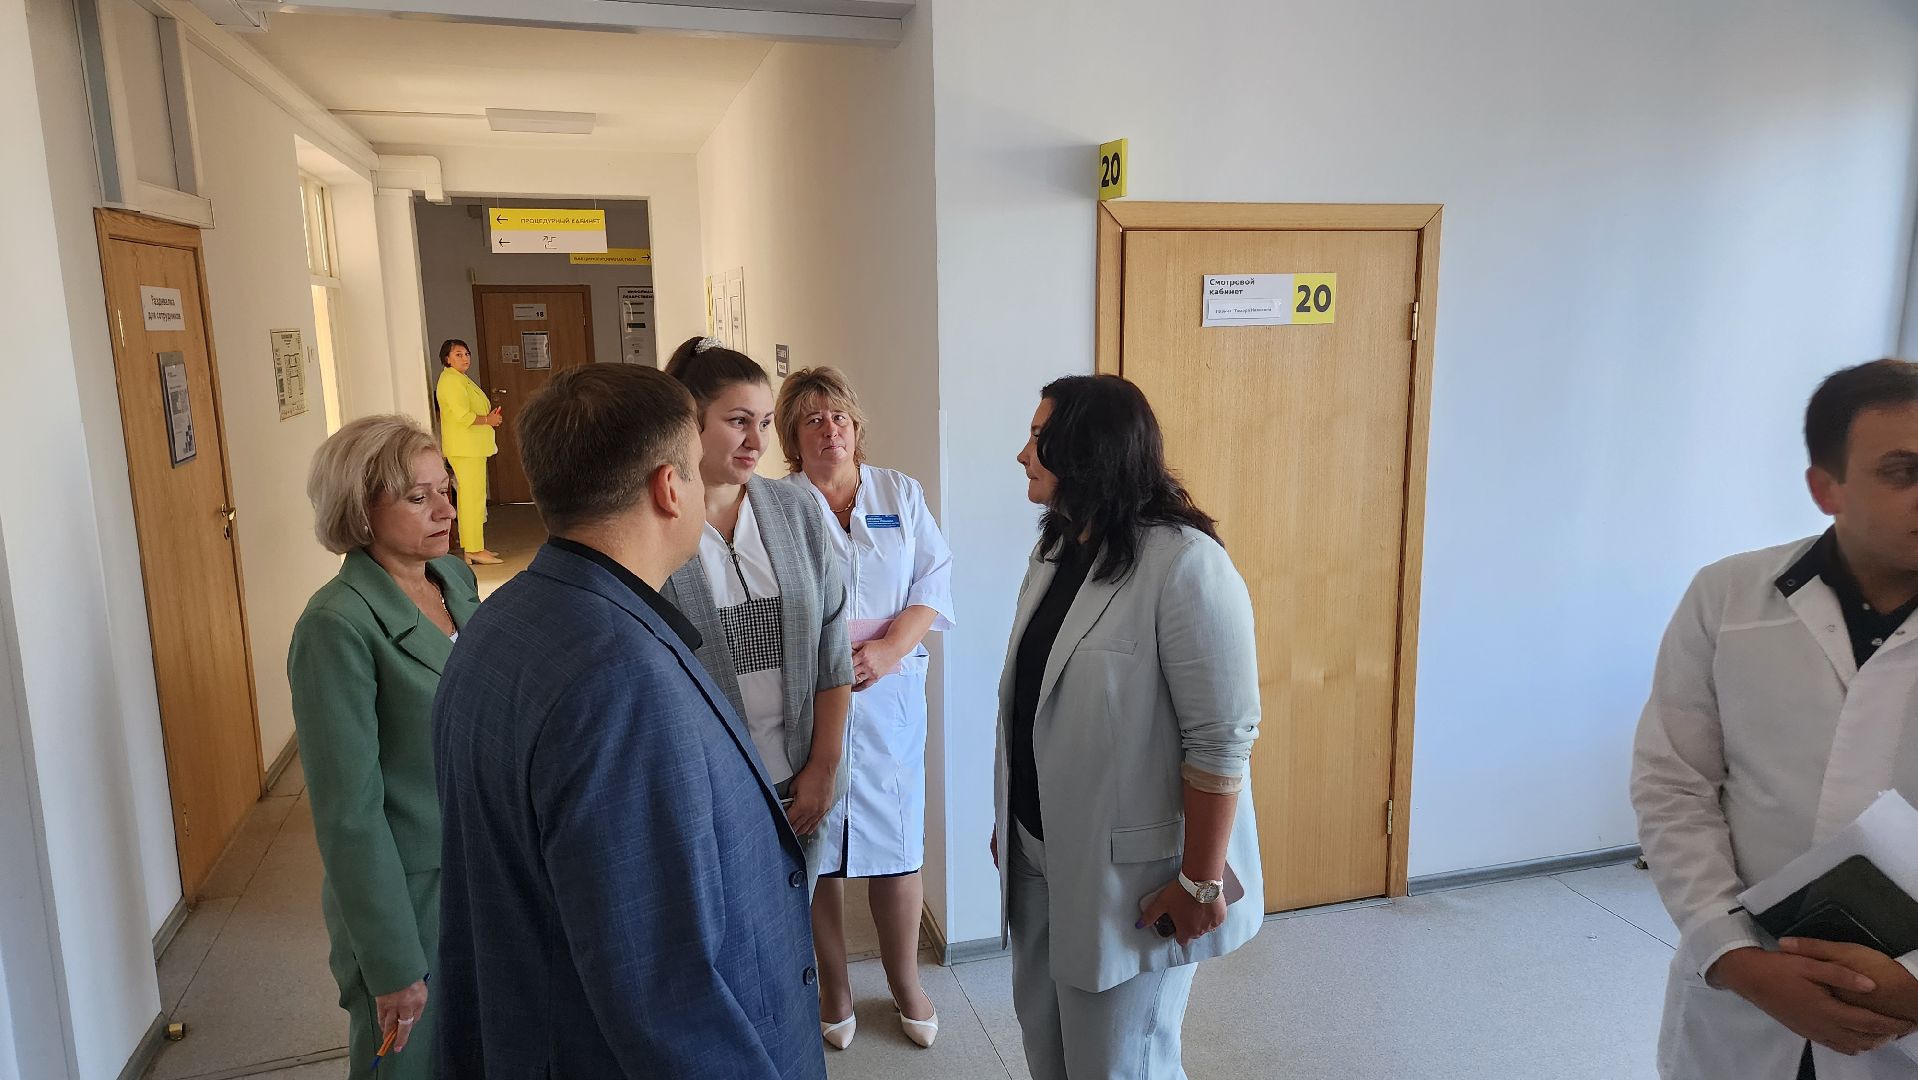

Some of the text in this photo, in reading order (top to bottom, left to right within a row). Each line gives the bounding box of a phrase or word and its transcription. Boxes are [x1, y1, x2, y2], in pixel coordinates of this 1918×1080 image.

[1101, 152, 1120, 187] 20
[520, 217, 570, 225] ПРОЦЕДУРНЫЙ
[1209, 278, 1255, 287] Смотровой
[1209, 288, 1243, 296] кабинет
[1296, 284, 1332, 313] 20
